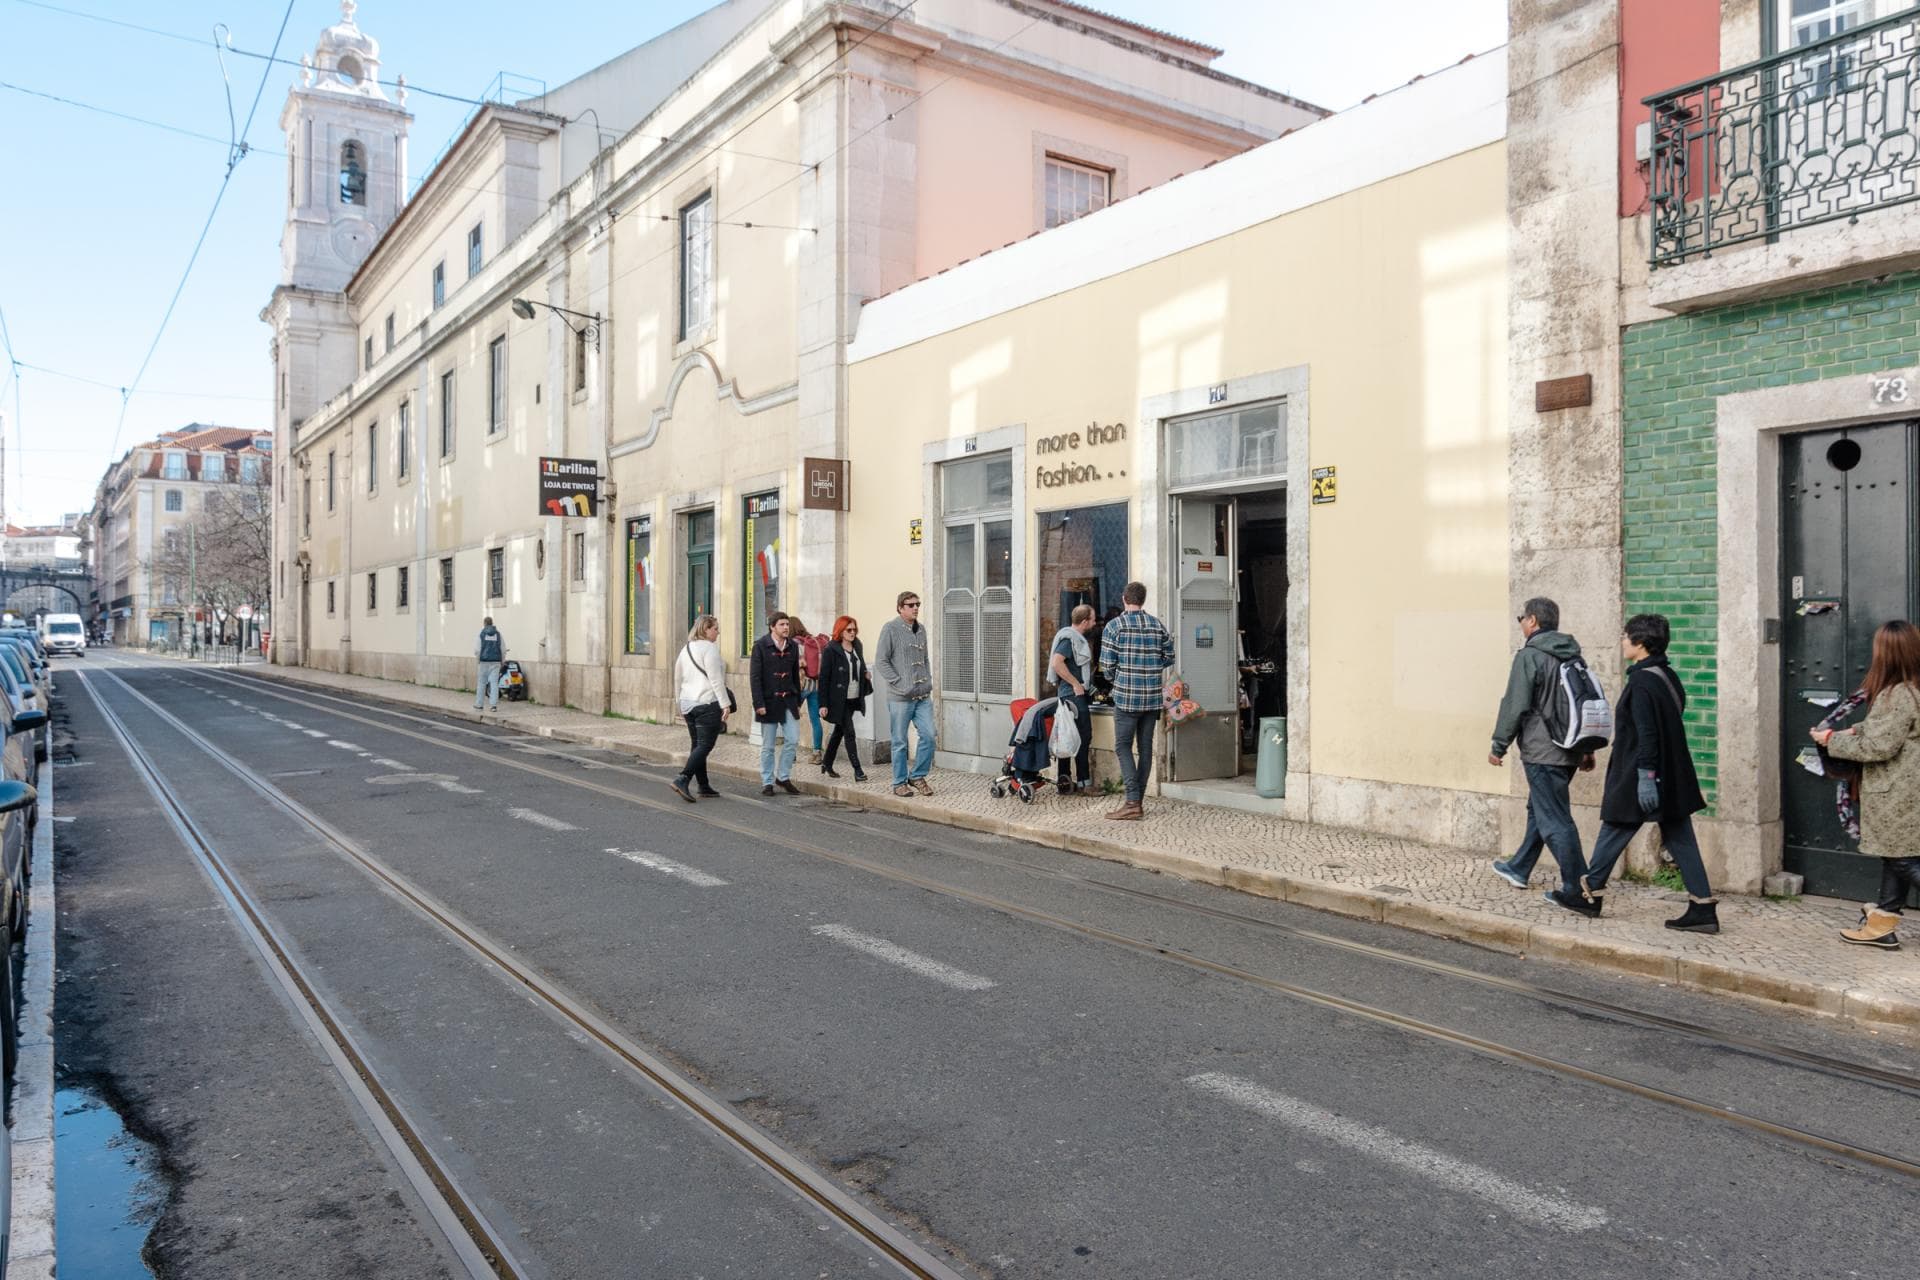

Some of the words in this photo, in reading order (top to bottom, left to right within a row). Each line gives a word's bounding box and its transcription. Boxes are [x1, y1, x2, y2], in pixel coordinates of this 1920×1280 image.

[1875, 376, 1907, 402] 73
[1037, 432, 1080, 454] more
[1086, 421, 1126, 446] than
